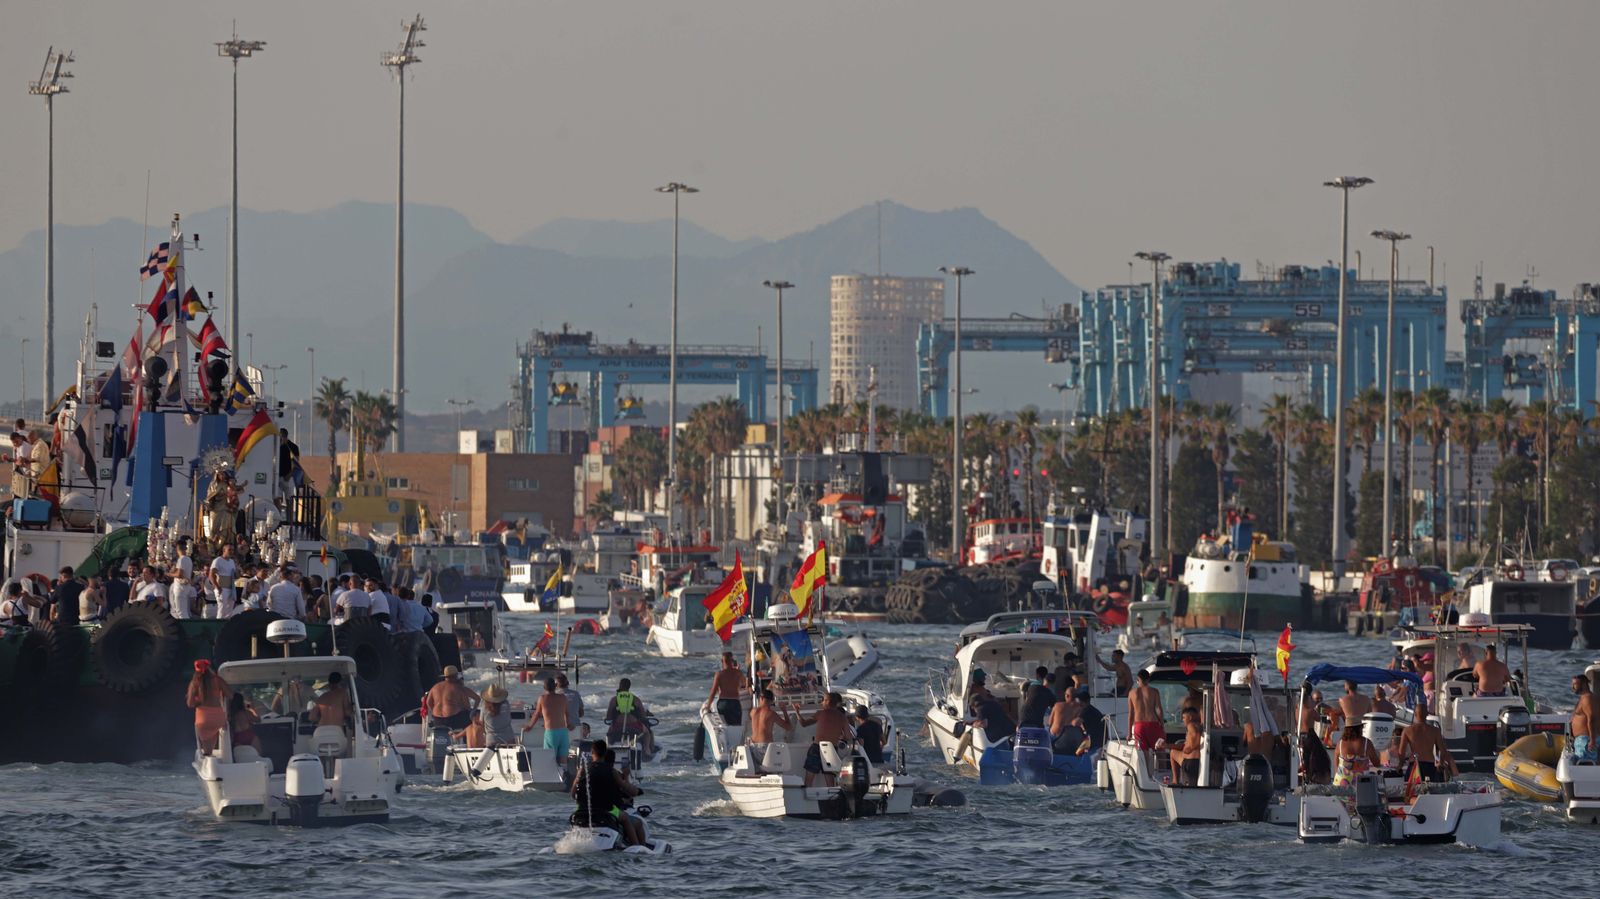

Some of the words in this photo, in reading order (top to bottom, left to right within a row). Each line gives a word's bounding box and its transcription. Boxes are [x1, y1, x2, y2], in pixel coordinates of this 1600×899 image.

[1295, 304, 1321, 317] 59
[1047, 339, 1071, 352] 48
[1286, 339, 1308, 350] 63
[626, 360, 684, 368] TERMINAS
